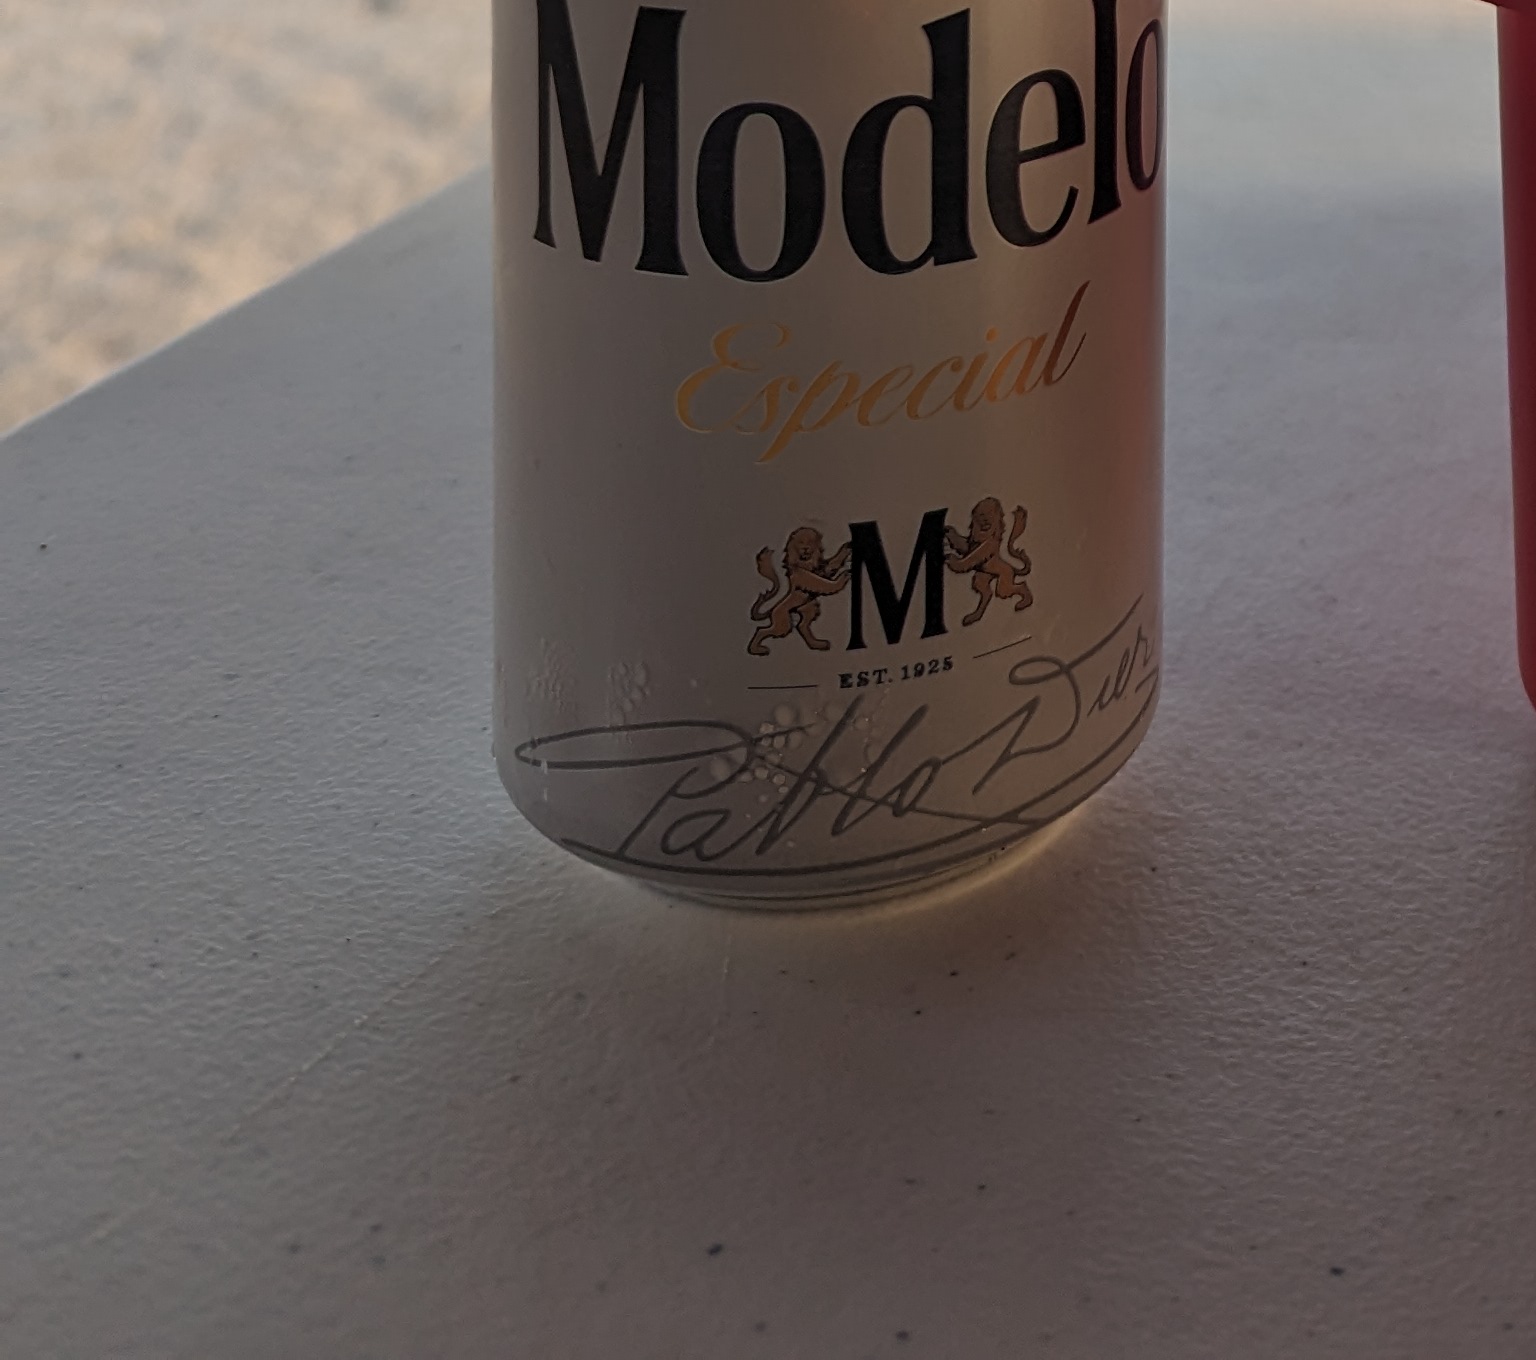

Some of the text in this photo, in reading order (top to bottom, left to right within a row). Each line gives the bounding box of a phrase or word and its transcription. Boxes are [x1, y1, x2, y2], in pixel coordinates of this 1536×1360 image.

[675, 279, 1091, 464] Especial
[845, 507, 950, 652] M
[838, 654, 954, 689] EST. 1925
